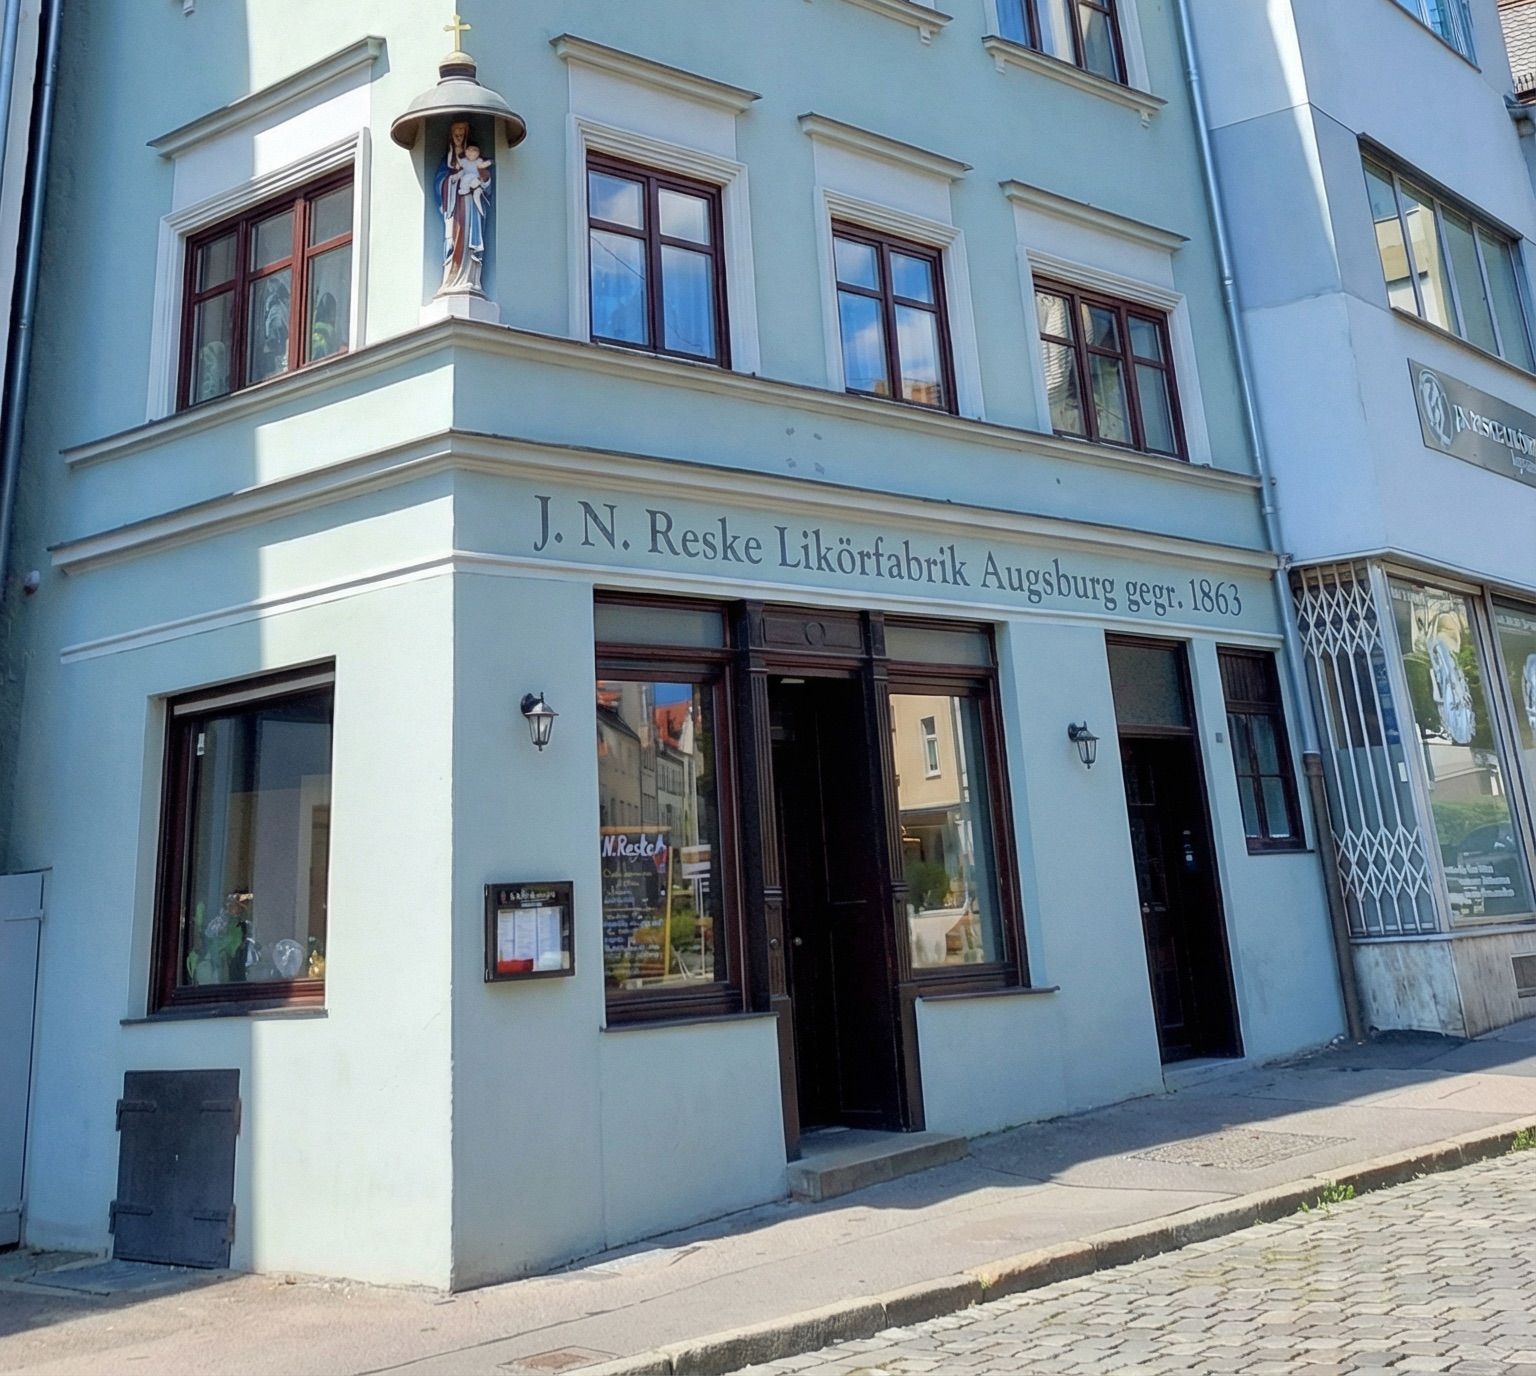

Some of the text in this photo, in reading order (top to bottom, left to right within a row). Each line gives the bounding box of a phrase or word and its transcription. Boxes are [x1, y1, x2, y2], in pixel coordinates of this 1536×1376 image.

[533, 494, 1242, 617] J. N. Reske Likörfabrik Augsburg gegr. 1863
